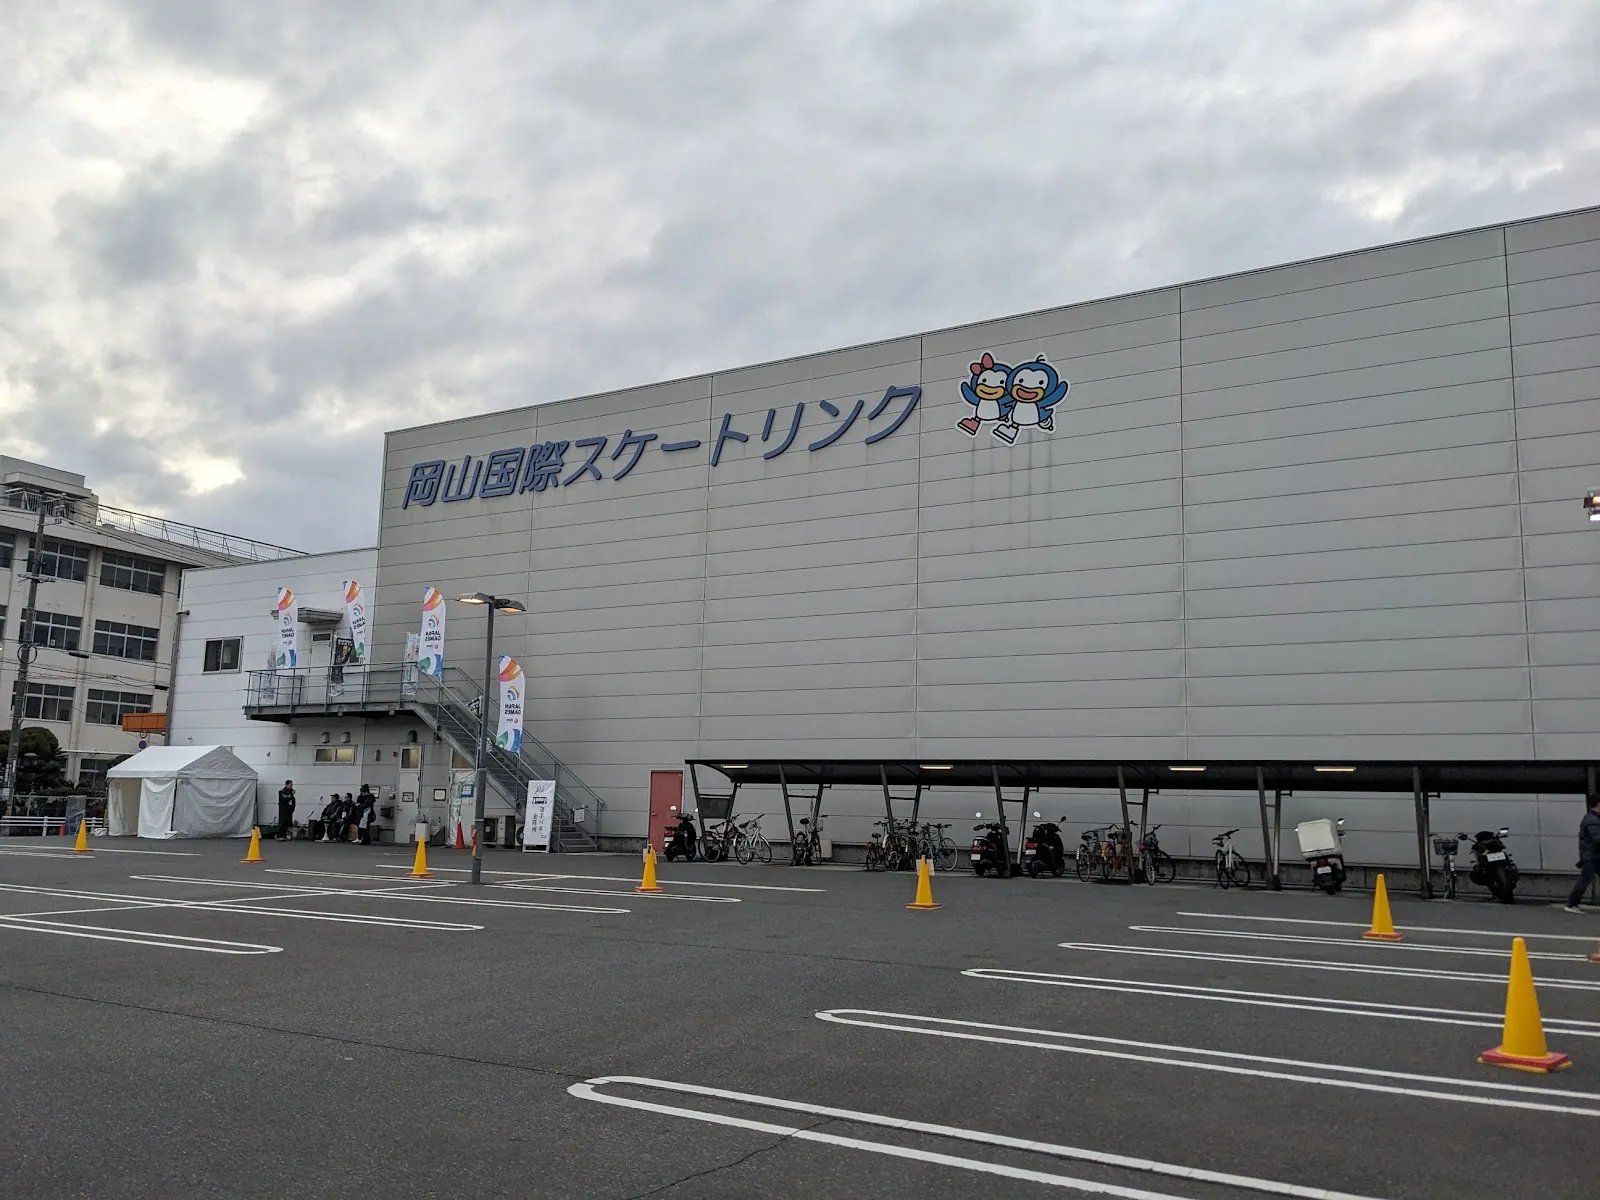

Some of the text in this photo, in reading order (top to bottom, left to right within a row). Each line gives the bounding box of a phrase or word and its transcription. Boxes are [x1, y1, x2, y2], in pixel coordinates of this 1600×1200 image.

[403, 385, 921, 509] 岡山国際スケートリンク
